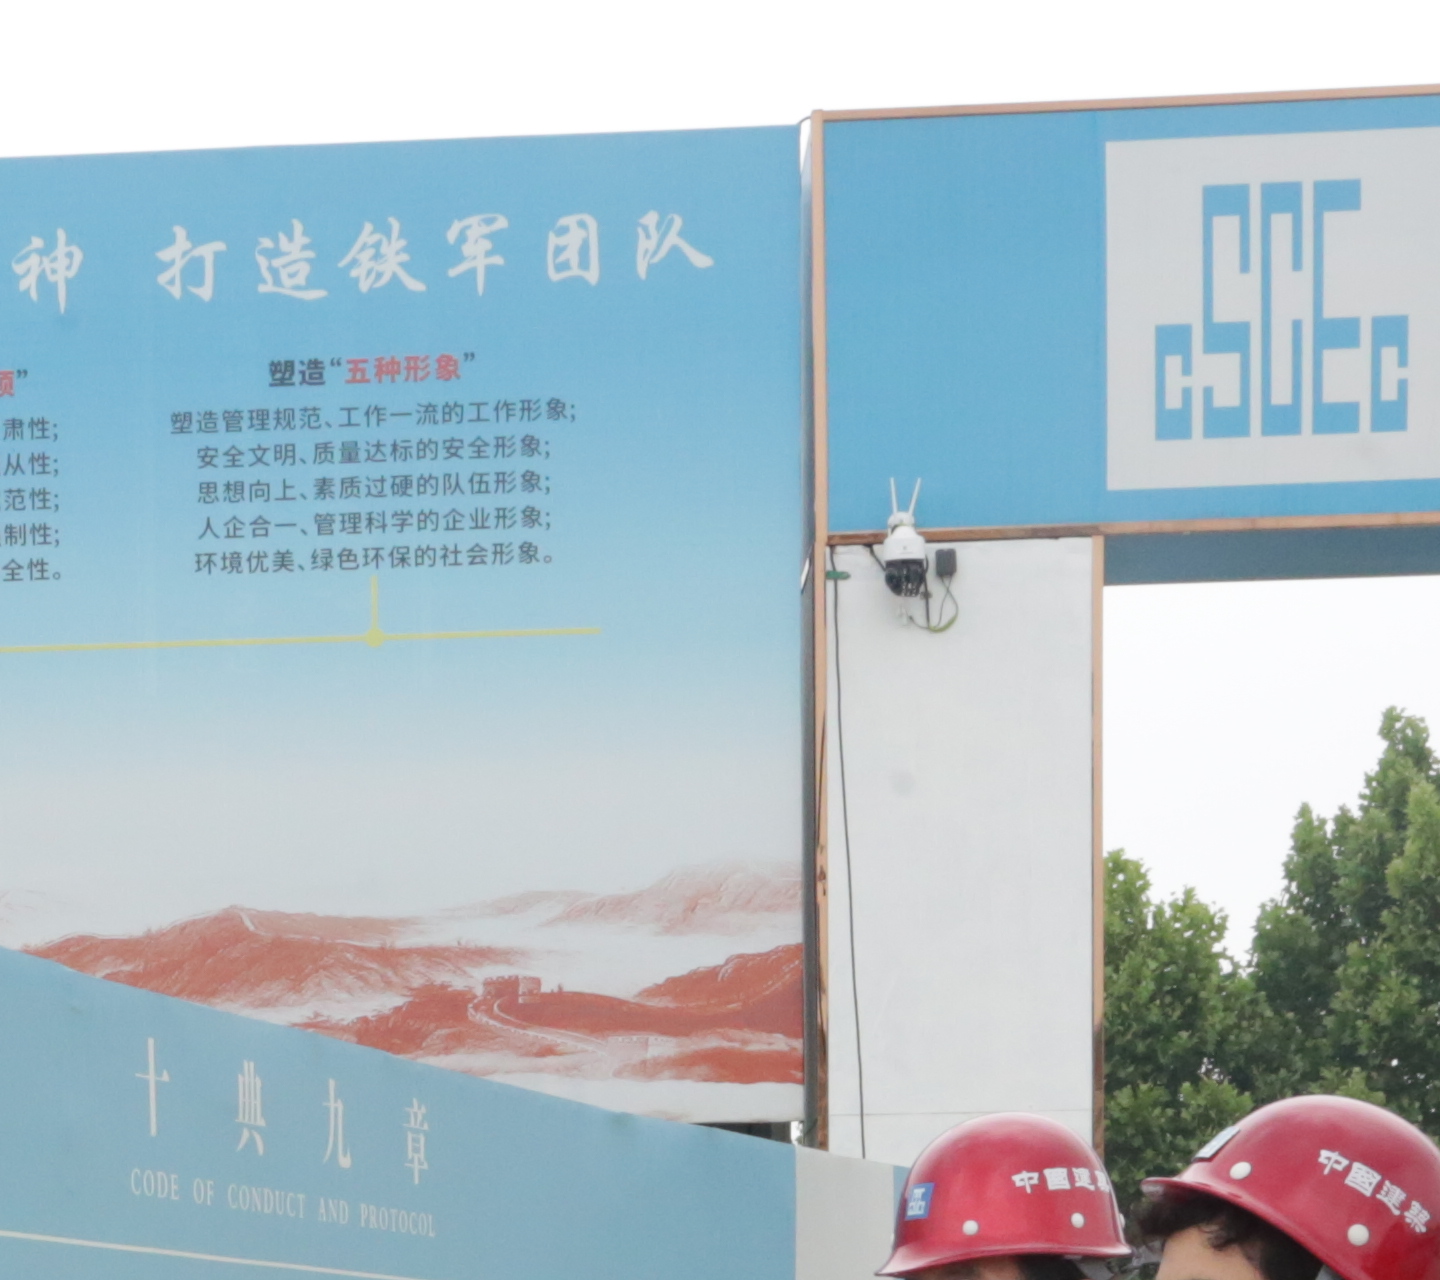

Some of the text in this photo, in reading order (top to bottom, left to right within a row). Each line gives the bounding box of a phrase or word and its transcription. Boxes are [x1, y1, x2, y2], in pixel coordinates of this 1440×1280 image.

[154, 208, 715, 303] 打造铁军团队
[194, 540, 554, 577] 环境优美、绿色环保的社会形象。
[134, 1036, 430, 1186] 十典九章
[130, 1167, 436, 1238] CODE OF CONDUCT AND PROTOCOL
[1317, 1149, 1432, 1234] 中國建築
